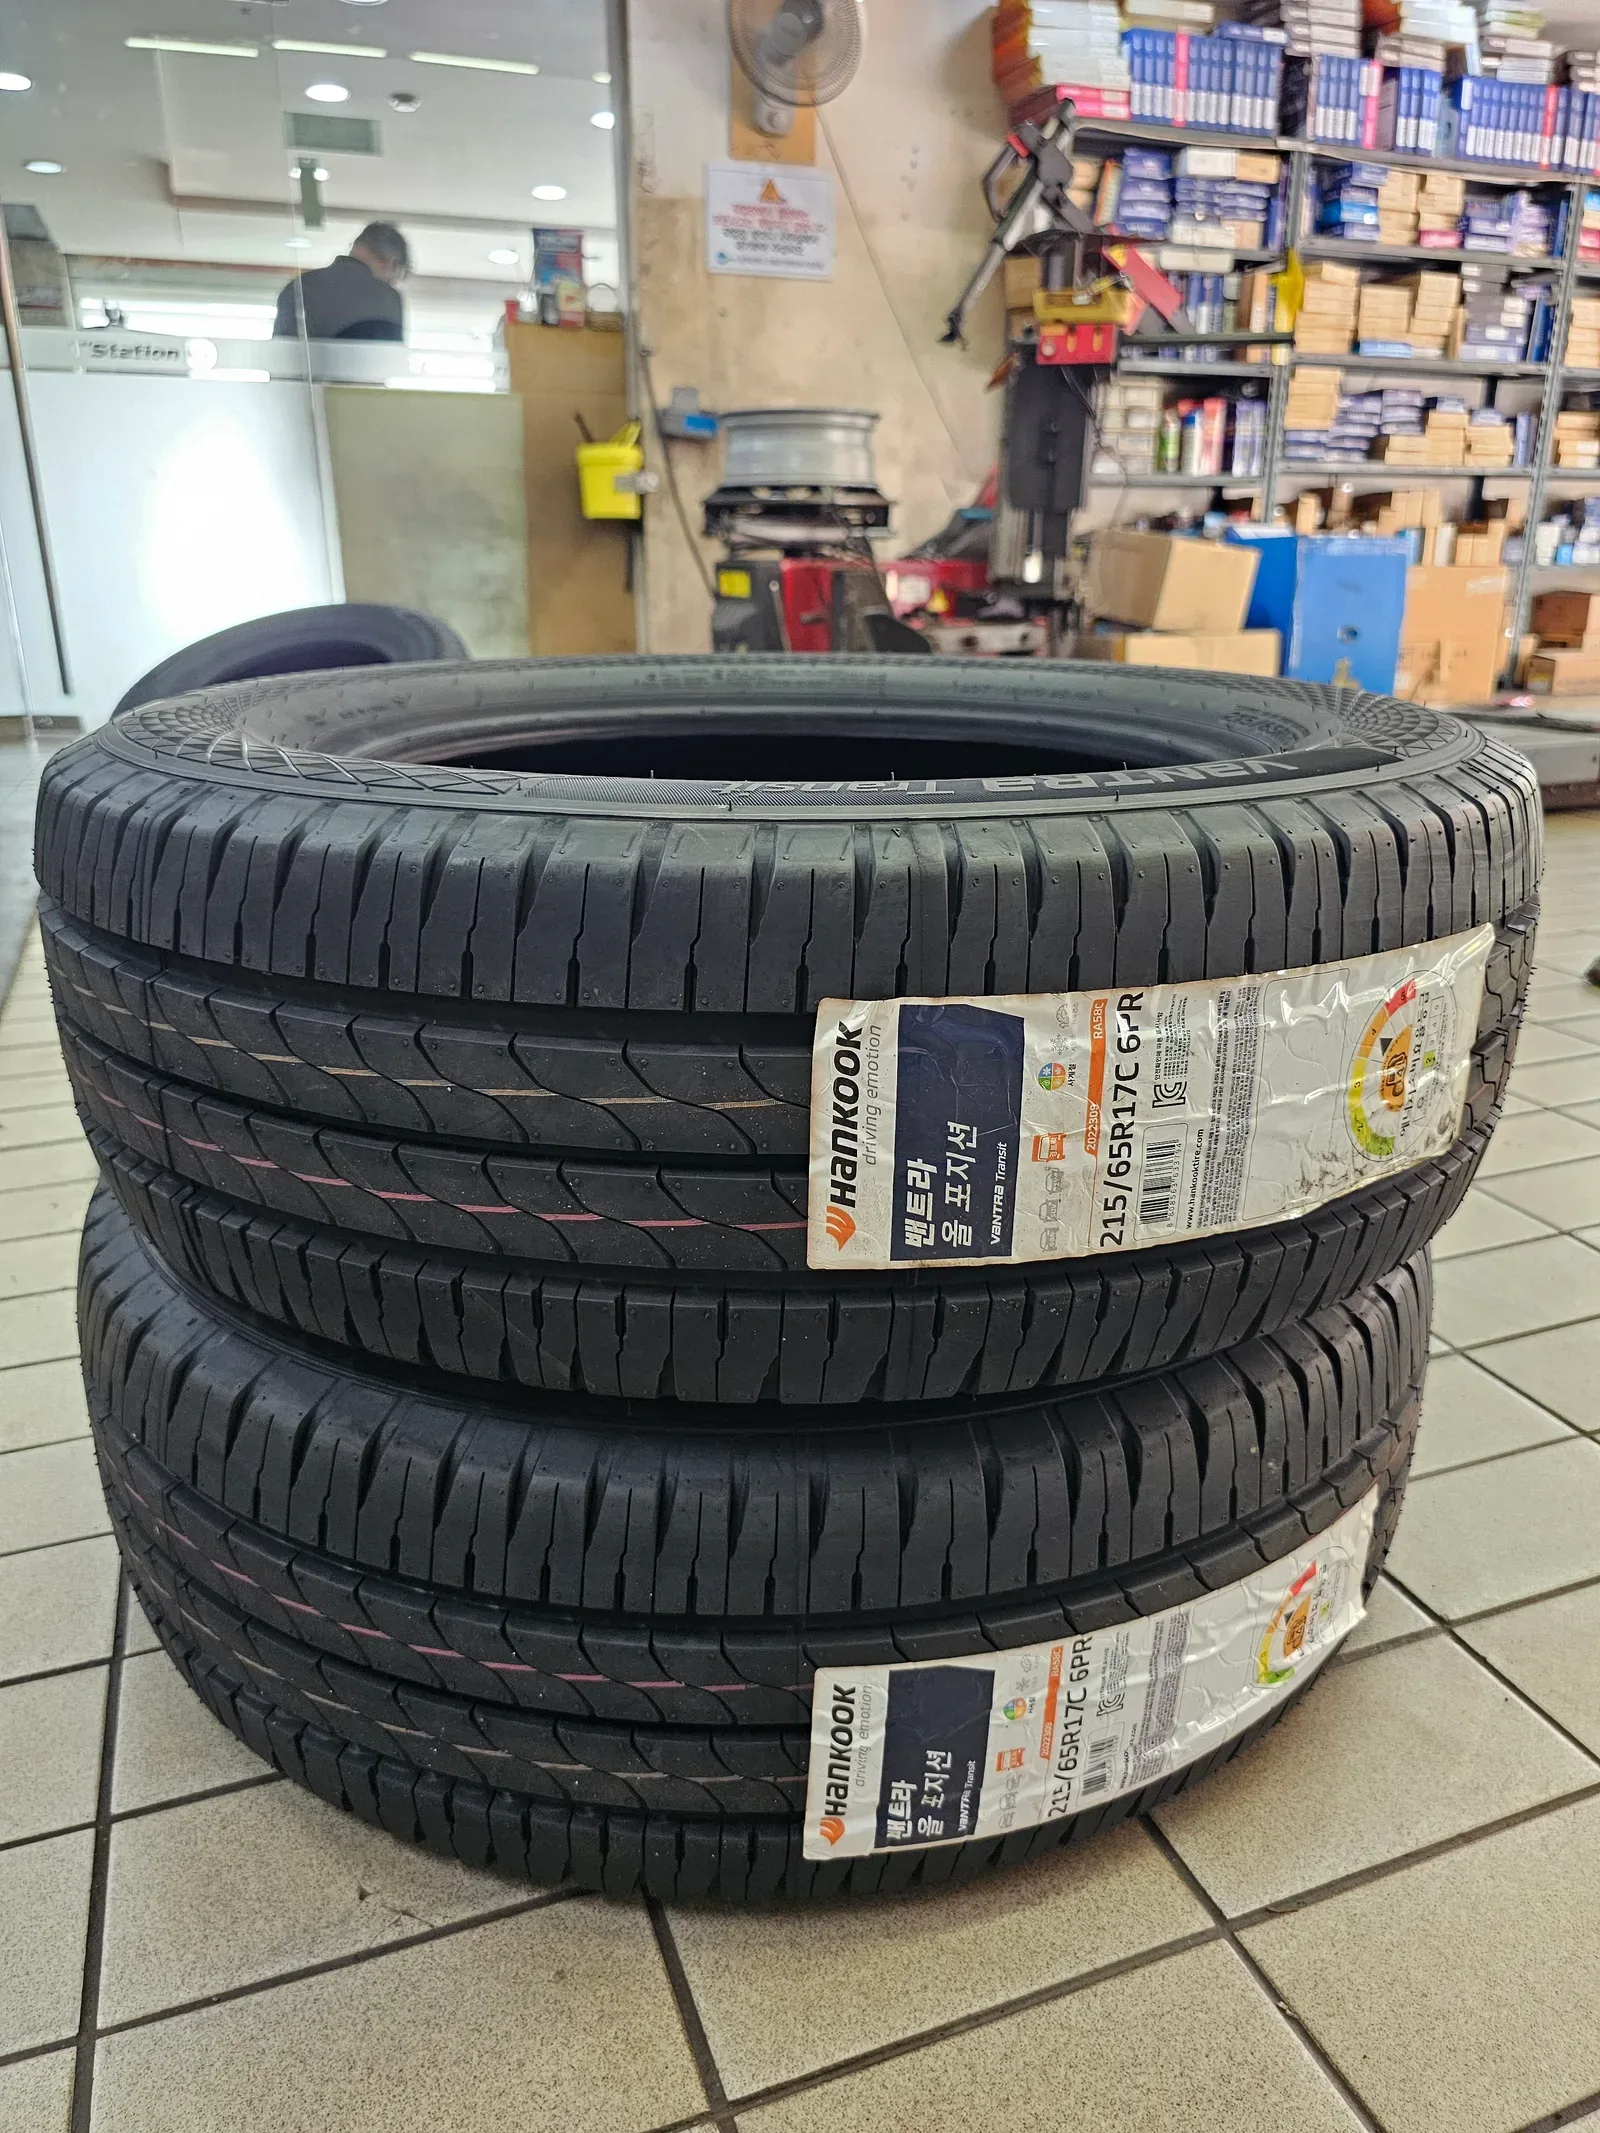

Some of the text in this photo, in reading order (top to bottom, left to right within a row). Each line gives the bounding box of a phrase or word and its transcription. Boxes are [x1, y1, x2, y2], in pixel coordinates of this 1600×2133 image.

[829, 1021, 864, 1208] Hankook
[864, 1023, 883, 1166] driving emotion
[1067, 1063, 1077, 1087] 사계절
[1086, 1002, 1105, 1151] 2022309 RA58C
[903, 1157, 938, 1248] 밴트라
[941, 1120, 978, 1248] 올 포지션
[995, 1141, 1008, 1182] Transit
[1099, 1063, 1140, 1248] 215/65R17C
[1184, 1128, 1204, 1230] www.hankooktire.com
[824, 1683, 857, 1816] Hankook
[855, 1683, 873, 1788] driving emotion
[1040, 1648, 1061, 1756] 2022309 RA58C
[1047, 1636, 1092, 1818] 215/65R17C 6PR
[886, 1779, 918, 1840] 밴트라
[917, 1749, 952, 1837] 올 포지션
[964, 1760, 976, 1788] Transit
